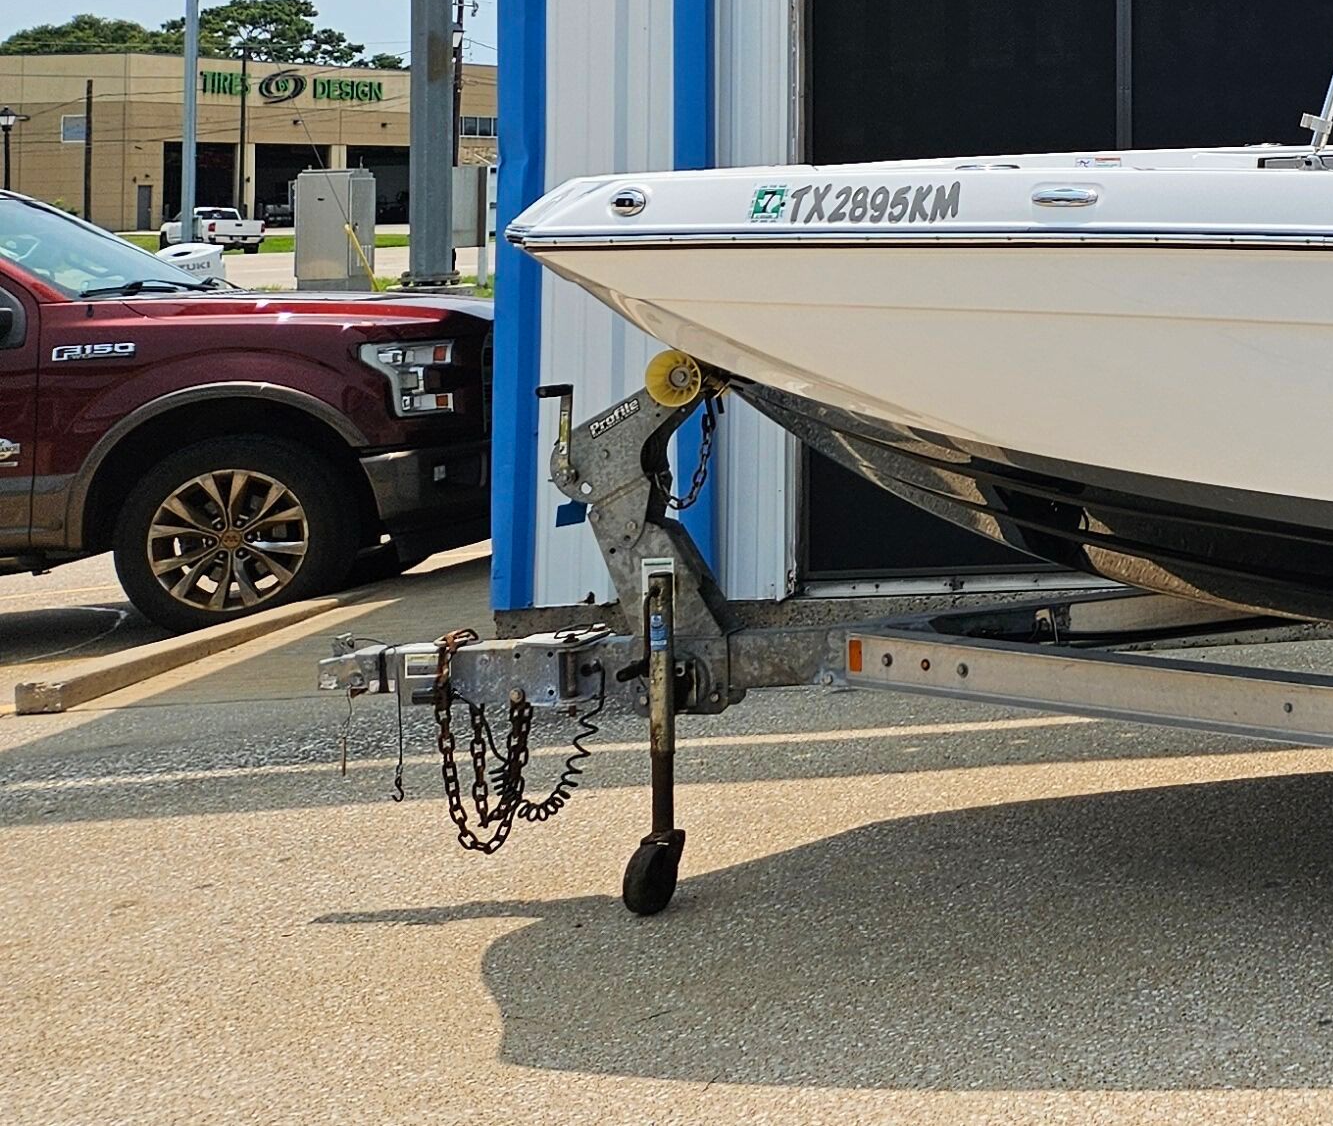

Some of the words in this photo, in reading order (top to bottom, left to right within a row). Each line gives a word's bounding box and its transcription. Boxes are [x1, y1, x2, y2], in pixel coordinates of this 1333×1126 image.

[312, 78, 384, 102] DESIGN
[790, 181, 962, 224] TX2895KM
[589, 399, 640, 436] Profile
